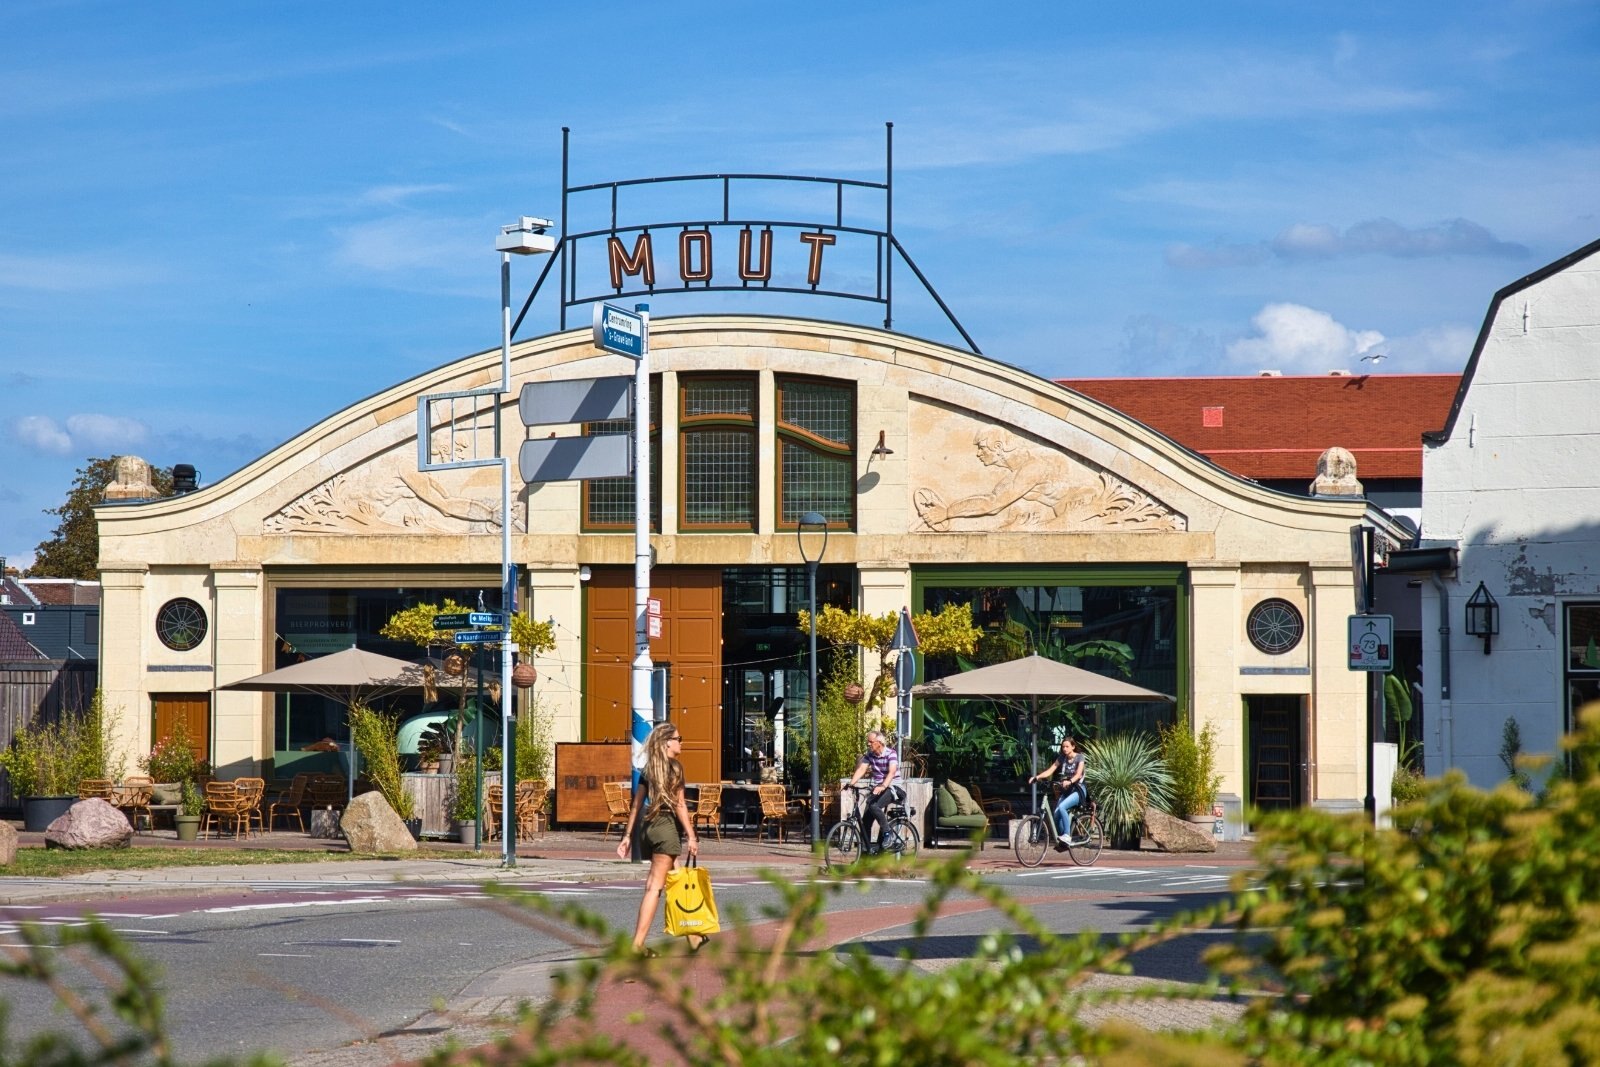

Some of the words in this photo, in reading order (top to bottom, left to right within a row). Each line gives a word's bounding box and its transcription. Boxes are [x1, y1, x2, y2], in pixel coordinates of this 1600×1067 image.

[607, 229, 836, 288] MOUT
[609, 312, 632, 332] Centrumring
[478, 615, 499, 623] Melkpad
[1363, 640, 1376, 650] 73
